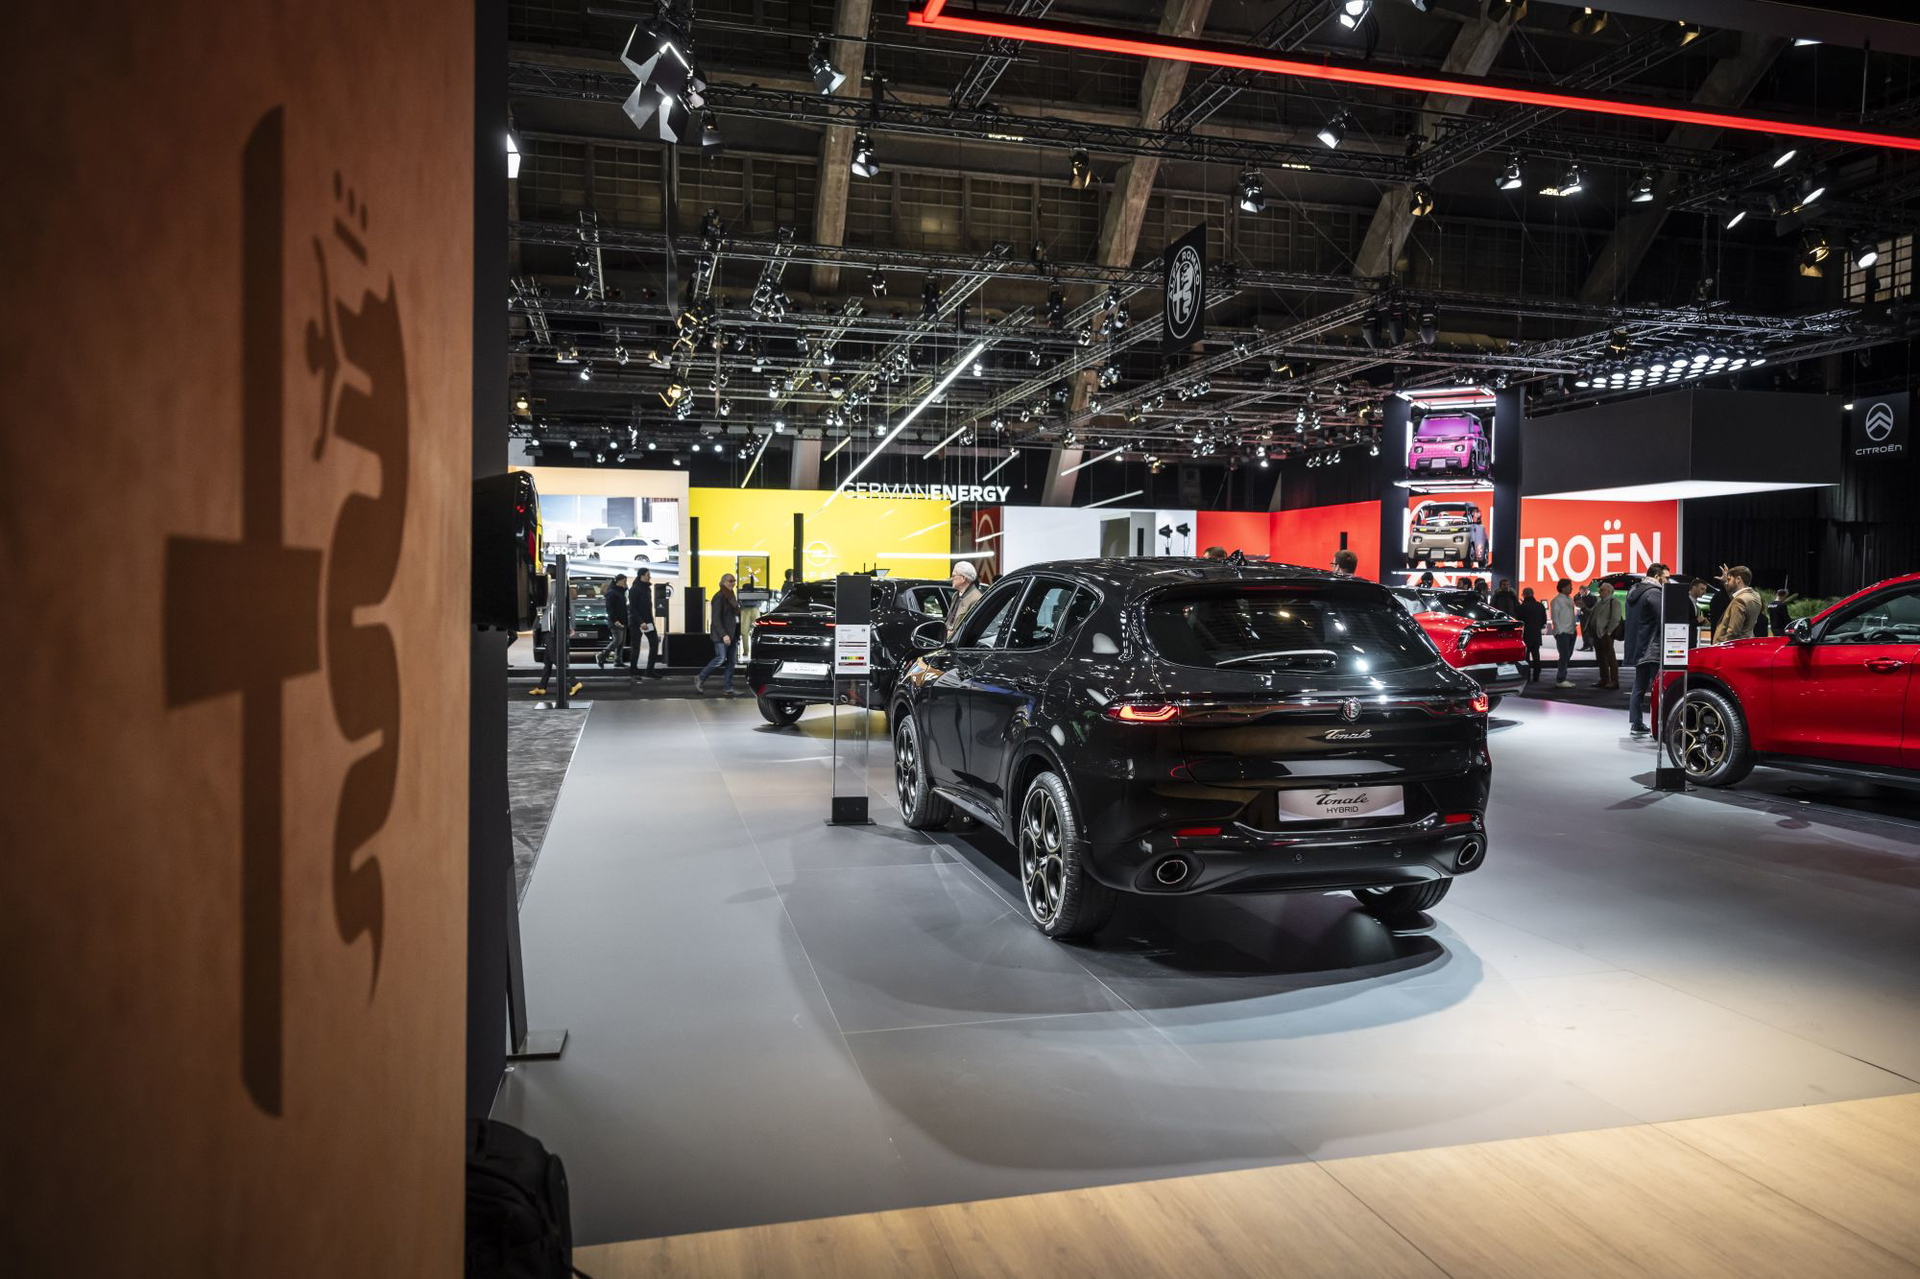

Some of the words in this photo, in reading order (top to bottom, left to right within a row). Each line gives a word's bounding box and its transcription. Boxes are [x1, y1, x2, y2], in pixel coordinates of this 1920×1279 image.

[1181, 250, 1200, 286] ROMEO
[1855, 443, 1902, 456] CITROËN
[1323, 728, 1372, 739] Tonale
[1315, 793, 1370, 805] Tonale
[1326, 805, 1359, 814] HYBRID
